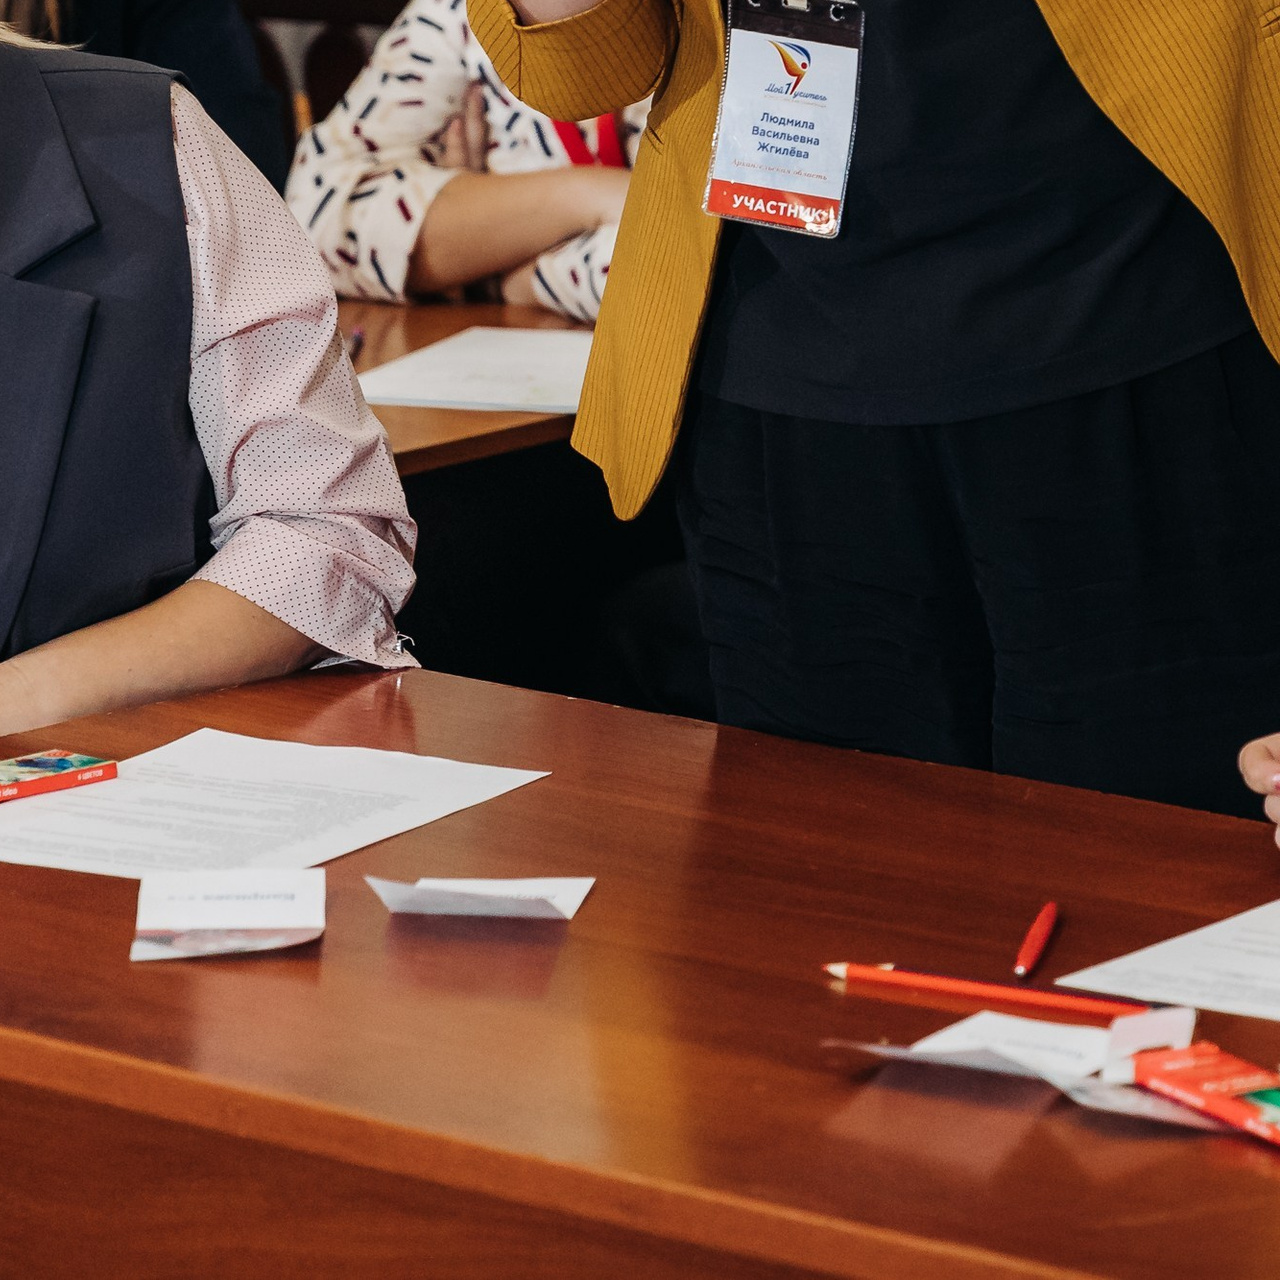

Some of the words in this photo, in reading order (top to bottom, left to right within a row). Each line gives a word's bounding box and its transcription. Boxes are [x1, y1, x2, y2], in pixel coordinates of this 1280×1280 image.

[761, 112, 815, 130] Людмила
[752, 126, 820, 146] Васильевна
[757, 141, 810, 159] Жгилёва
